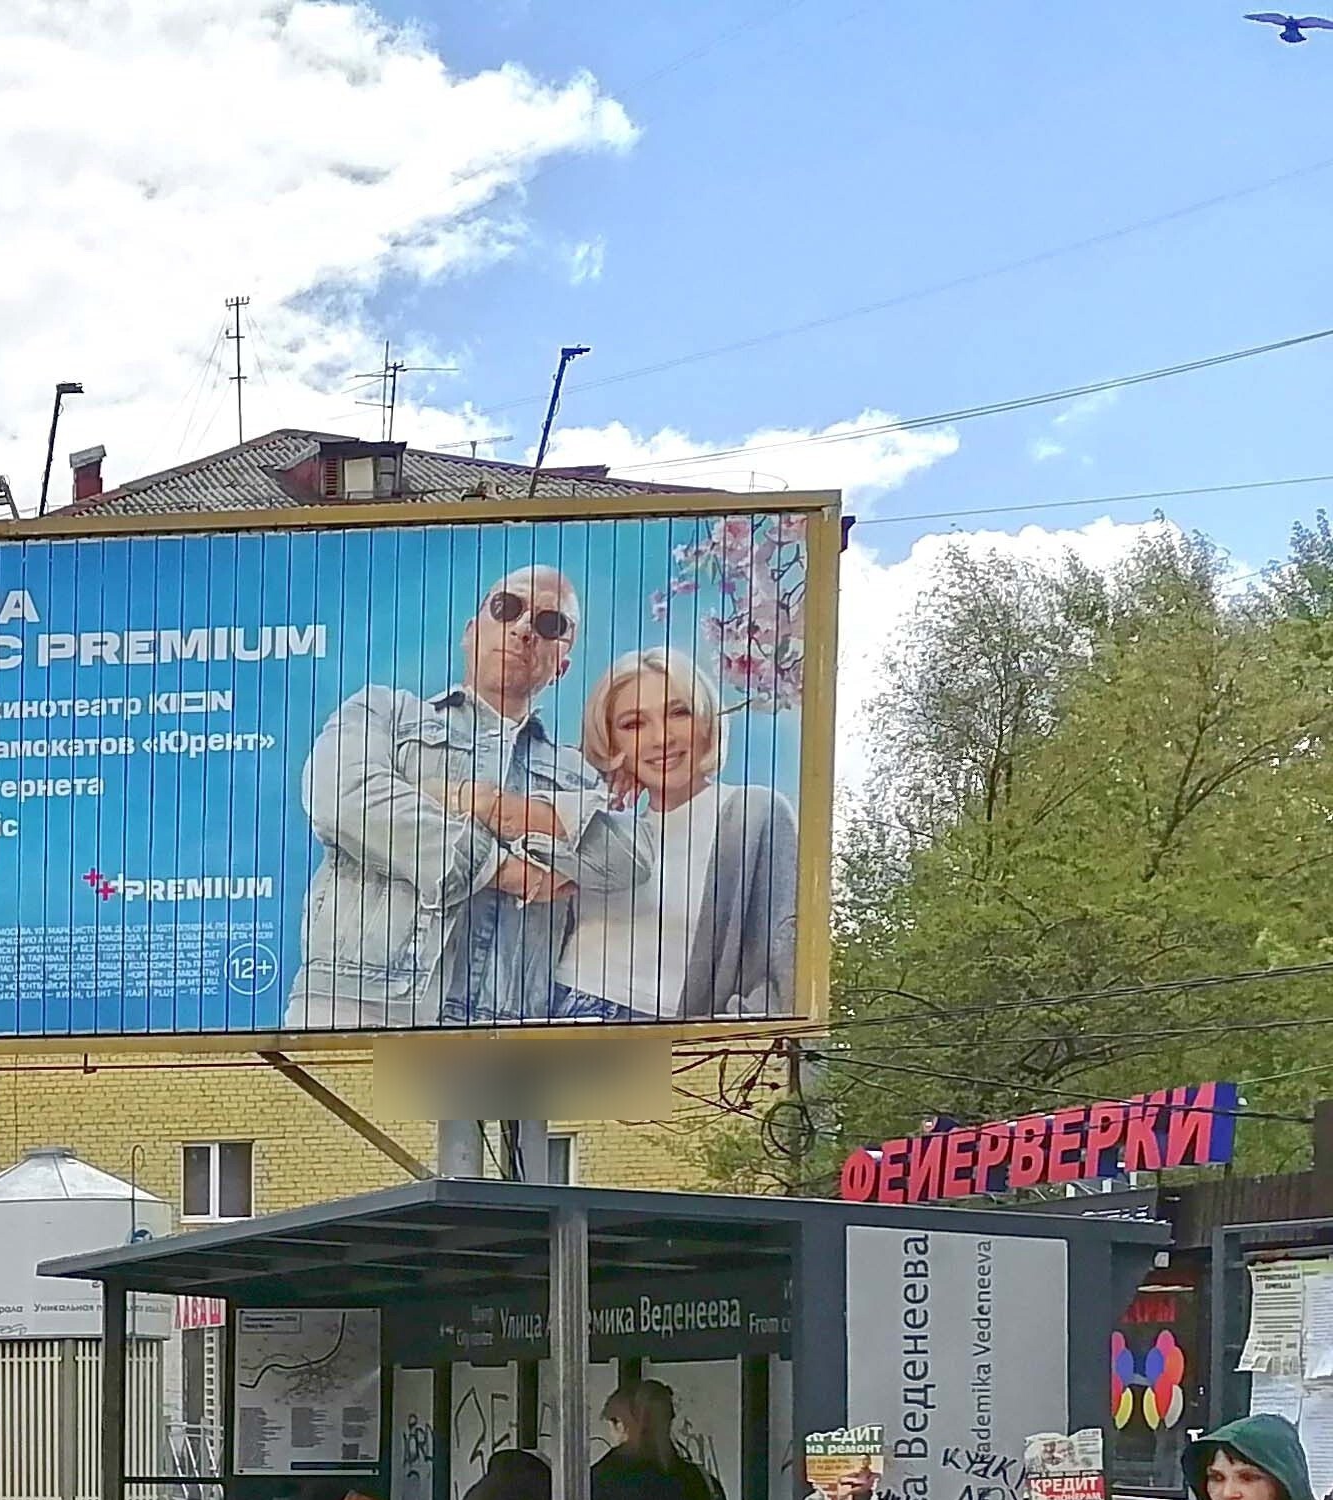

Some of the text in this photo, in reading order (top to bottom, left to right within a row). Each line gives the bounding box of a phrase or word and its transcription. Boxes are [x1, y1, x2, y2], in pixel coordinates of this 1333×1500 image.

[38, 624, 327, 668] PREMIUM
[149, 689, 233, 715] KION
[142, 730, 275, 759] «Юрент»
[126, 876, 273, 902] PREMIUM
[232, 957, 272, 979] 12+
[840, 1081, 1221, 1202] ФЕЙЕРВЕРКИ
[33, 1303, 94, 1313] Уникальная
[970, 1239, 992, 1357] Vedeneeva
[498, 1306, 543, 1340] Улица
[639, 1295, 742, 1340] Веденеева
[748, 1311, 780, 1337] From
[894, 1233, 936, 1459] Веденеева
[806, 1444, 882, 1456] на ремонт
[1030, 1476, 1099, 1495] КРЕДИТ
